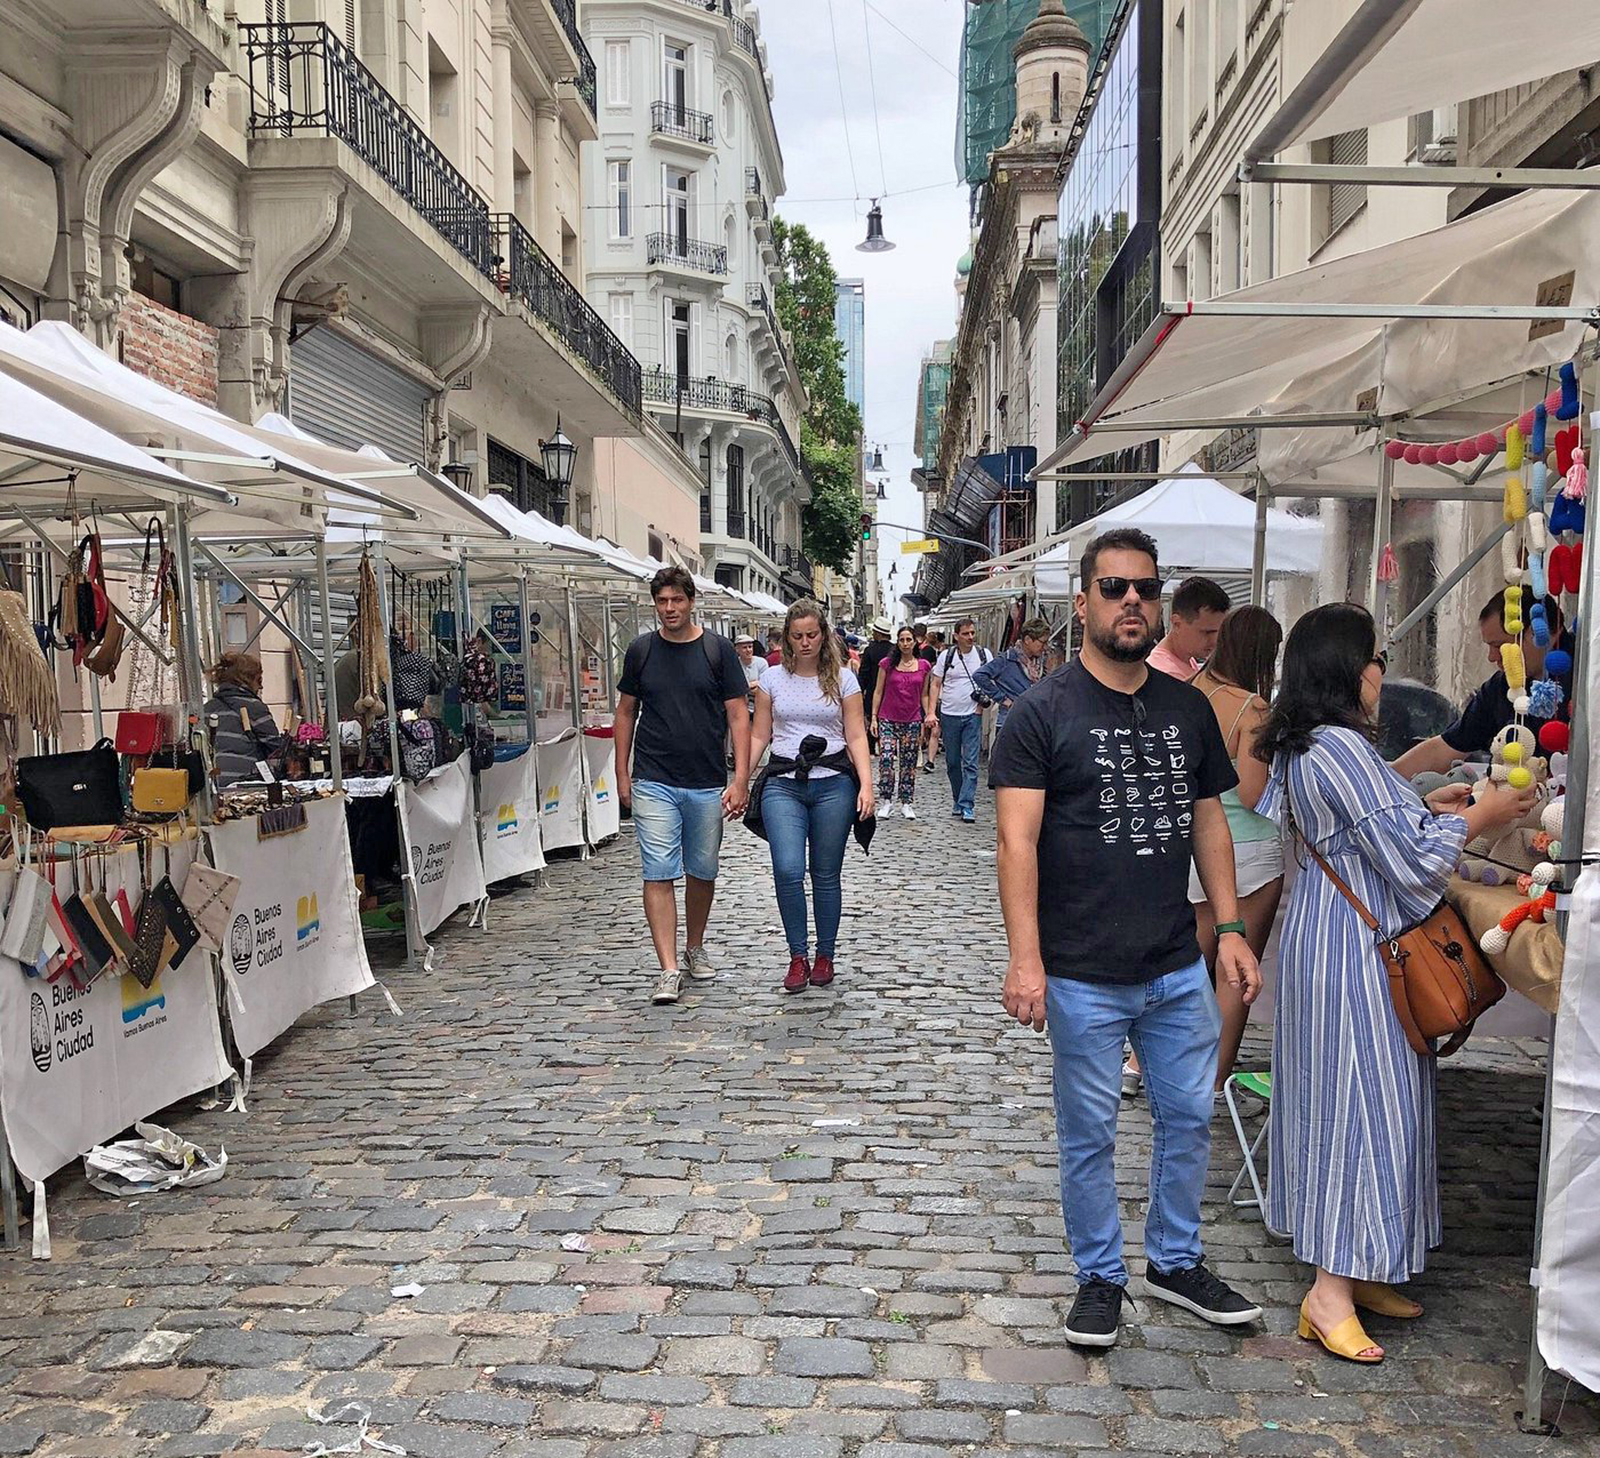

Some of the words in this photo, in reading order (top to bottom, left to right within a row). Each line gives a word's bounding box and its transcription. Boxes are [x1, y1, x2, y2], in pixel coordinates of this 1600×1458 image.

[427, 840, 451, 856] Buenos
[423, 857, 444, 871] Aires
[254, 904, 282, 925] Buenos
[256, 927, 276, 947] Aires
[257, 939, 283, 967] Ciudad
[54, 1008, 83, 1036] Aires
[138, 1020, 155, 1032] Buenos
[155, 1015, 167, 1025] Aires
[56, 1025, 94, 1062] Ciudad
